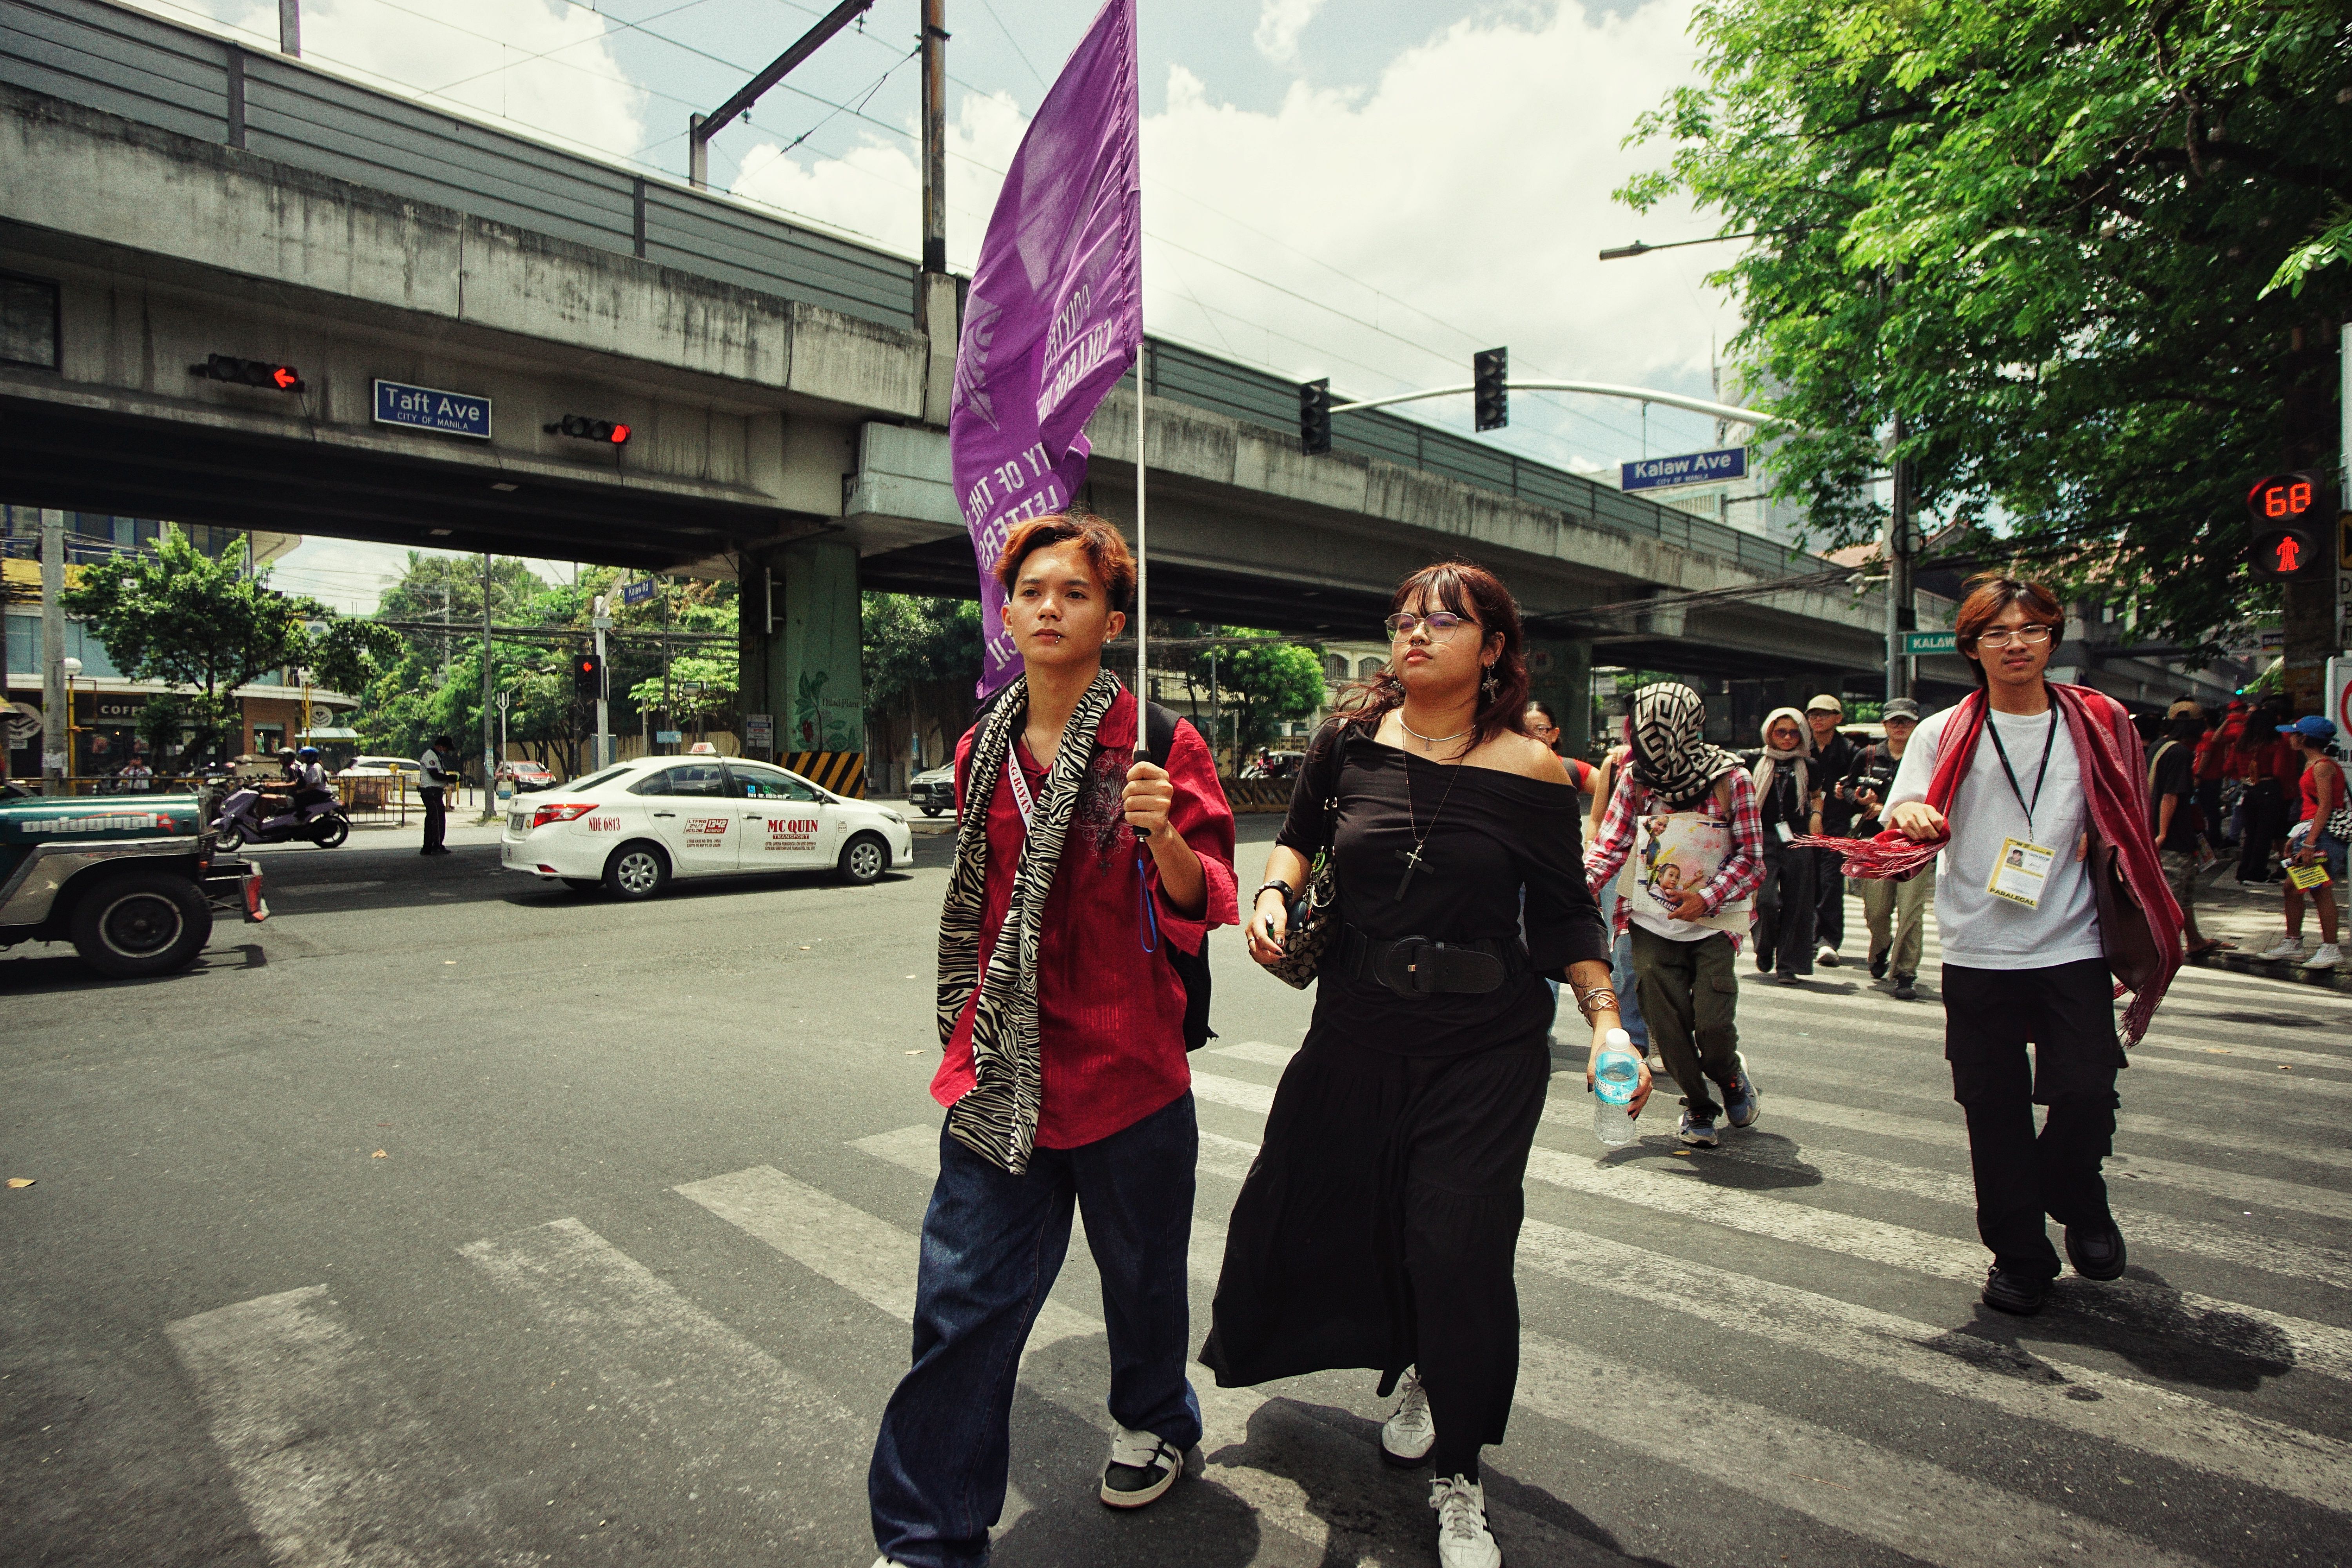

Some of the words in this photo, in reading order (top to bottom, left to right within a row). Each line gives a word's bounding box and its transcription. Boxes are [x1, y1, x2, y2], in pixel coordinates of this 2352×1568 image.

[386, 387, 429, 414] Taft
[437, 397, 480, 421] Ave
[397, 412, 417, 423] CITY
[422, 415, 432, 425] OF
[437, 418, 468, 430] MANILA
[1635, 459, 1689, 478] Kalaw
[1694, 454, 1731, 471] Ave
[2265, 483, 2312, 517] 68
[629, 586, 642, 597] Kalaw
[642, 582, 648, 592] Rd
[1913, 636, 1956, 648] KALAW
[1009, 758, 1018, 776] NG
[1013, 777, 1033, 815] BAYAN
[588, 817, 602, 831] NDE
[604, 817, 621, 831] 6813
[768, 820, 786, 833] MC
[788, 820, 818, 834] QUIN
[1653, 897, 1677, 911] ALEND
[1990, 887, 2035, 906] PARALEGAL
